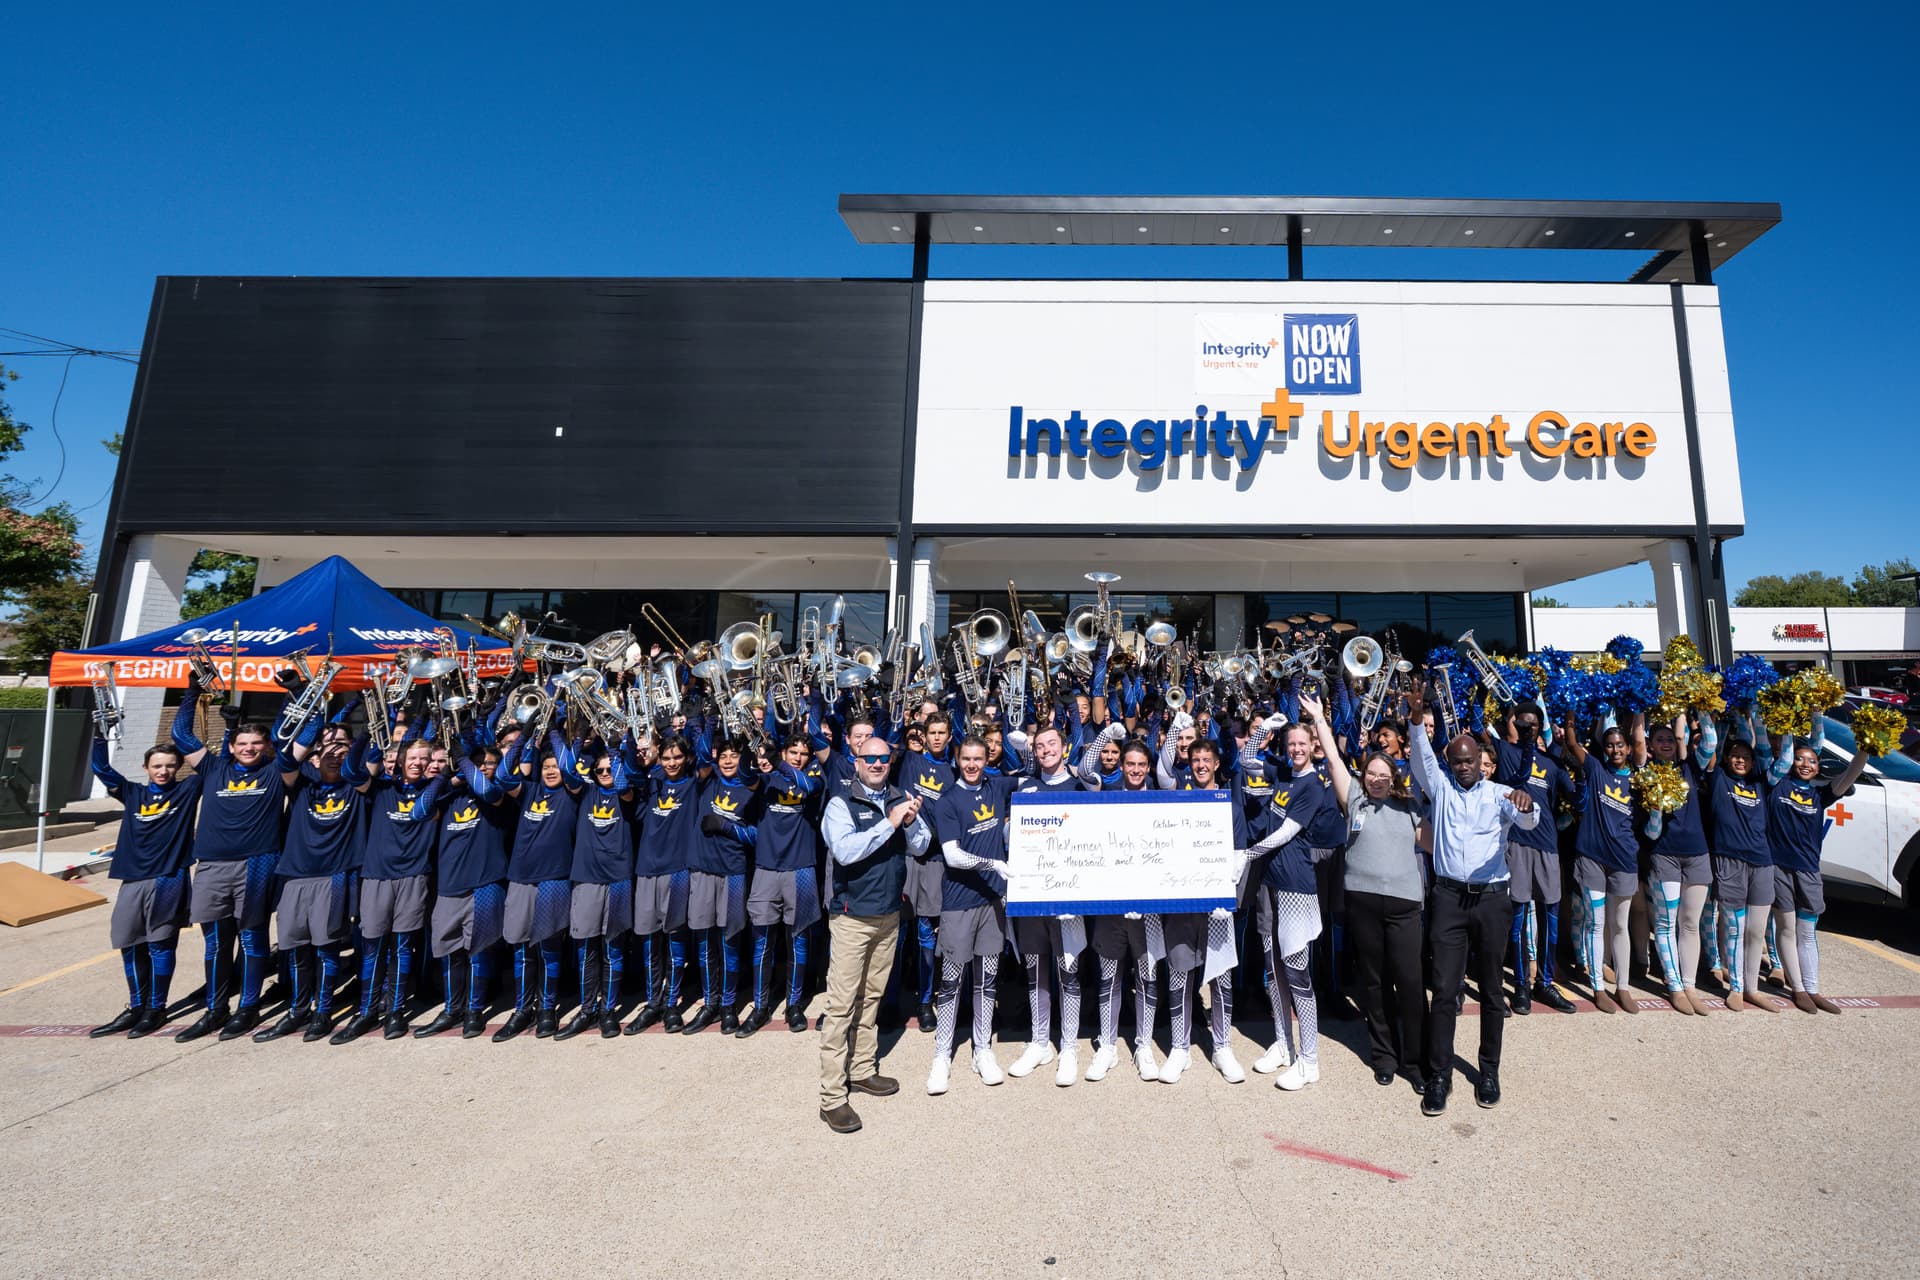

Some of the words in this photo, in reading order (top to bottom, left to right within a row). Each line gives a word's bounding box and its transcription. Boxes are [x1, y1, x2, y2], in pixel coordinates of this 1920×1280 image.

[1292, 324, 1351, 355] NOW
[1203, 342, 1270, 358] Integrity
[1203, 360, 1235, 370] Urgent
[1293, 357, 1352, 384] OPEN
[1008, 405, 1272, 471] Integrity
[1322, 410, 1512, 468] Urgent
[1527, 411, 1657, 458] Care
[1021, 816, 1064, 827] Integrity
[1042, 874, 1079, 890] Band
